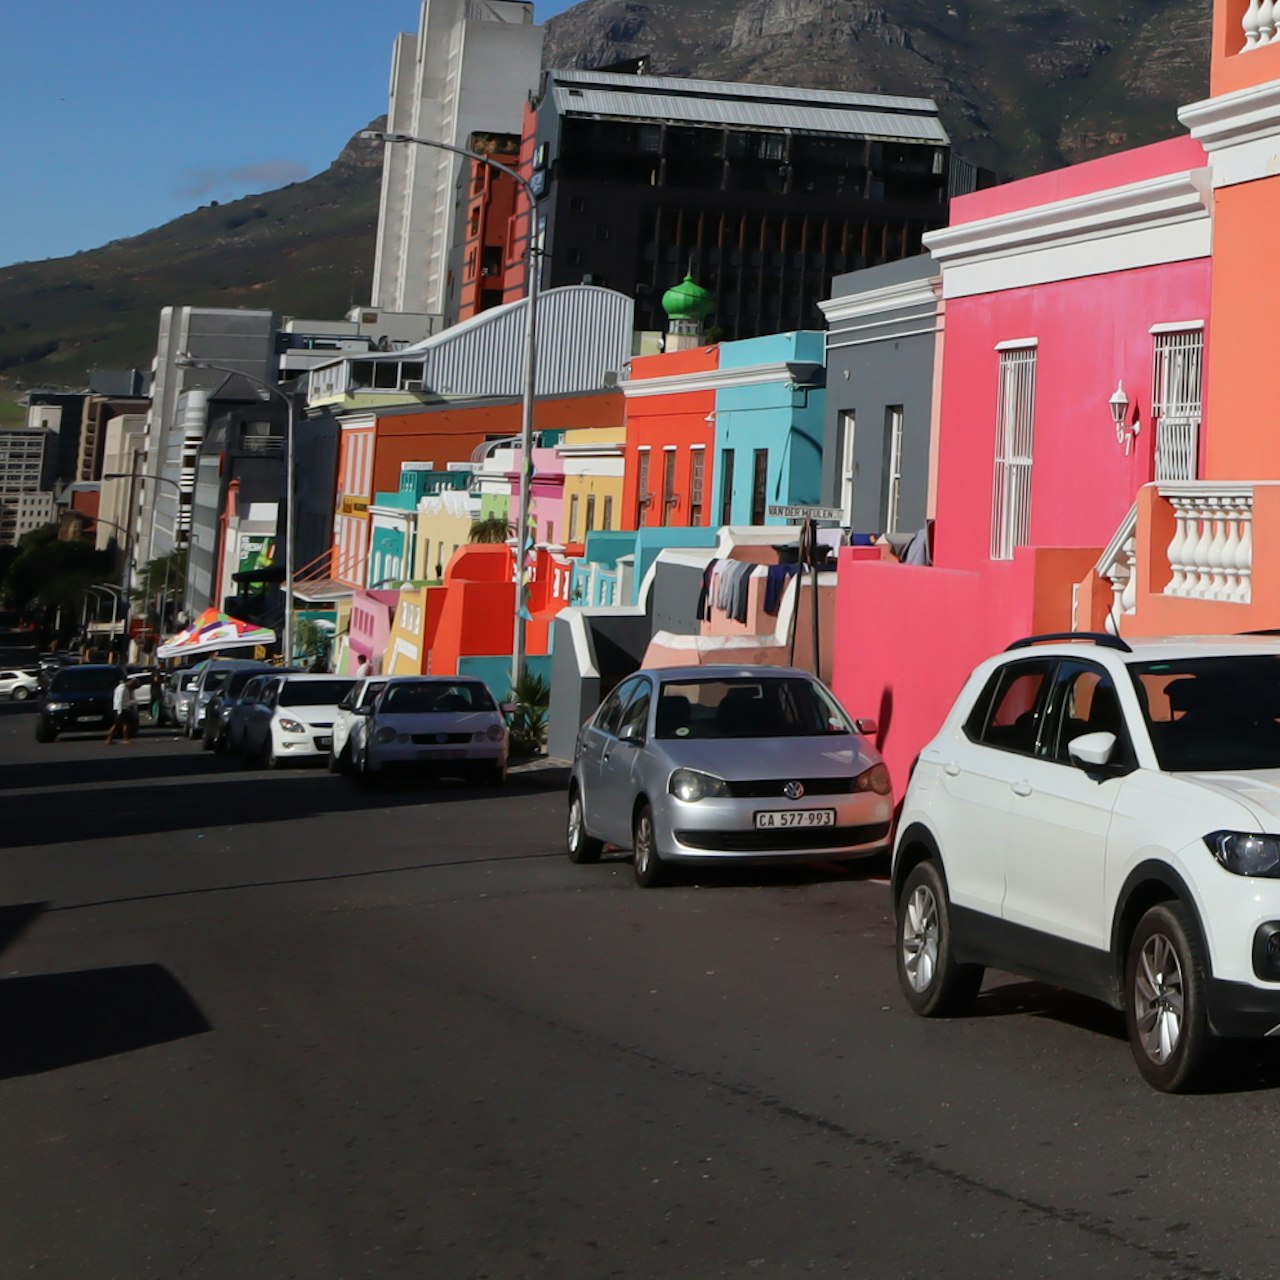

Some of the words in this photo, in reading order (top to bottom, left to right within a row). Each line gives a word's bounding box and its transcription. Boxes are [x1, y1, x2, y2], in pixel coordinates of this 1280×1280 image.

[768, 506, 783, 516] VAN
[784, 507, 800, 517] DER
[802, 508, 833, 519] MEULEN
[759, 814, 775, 827] CA
